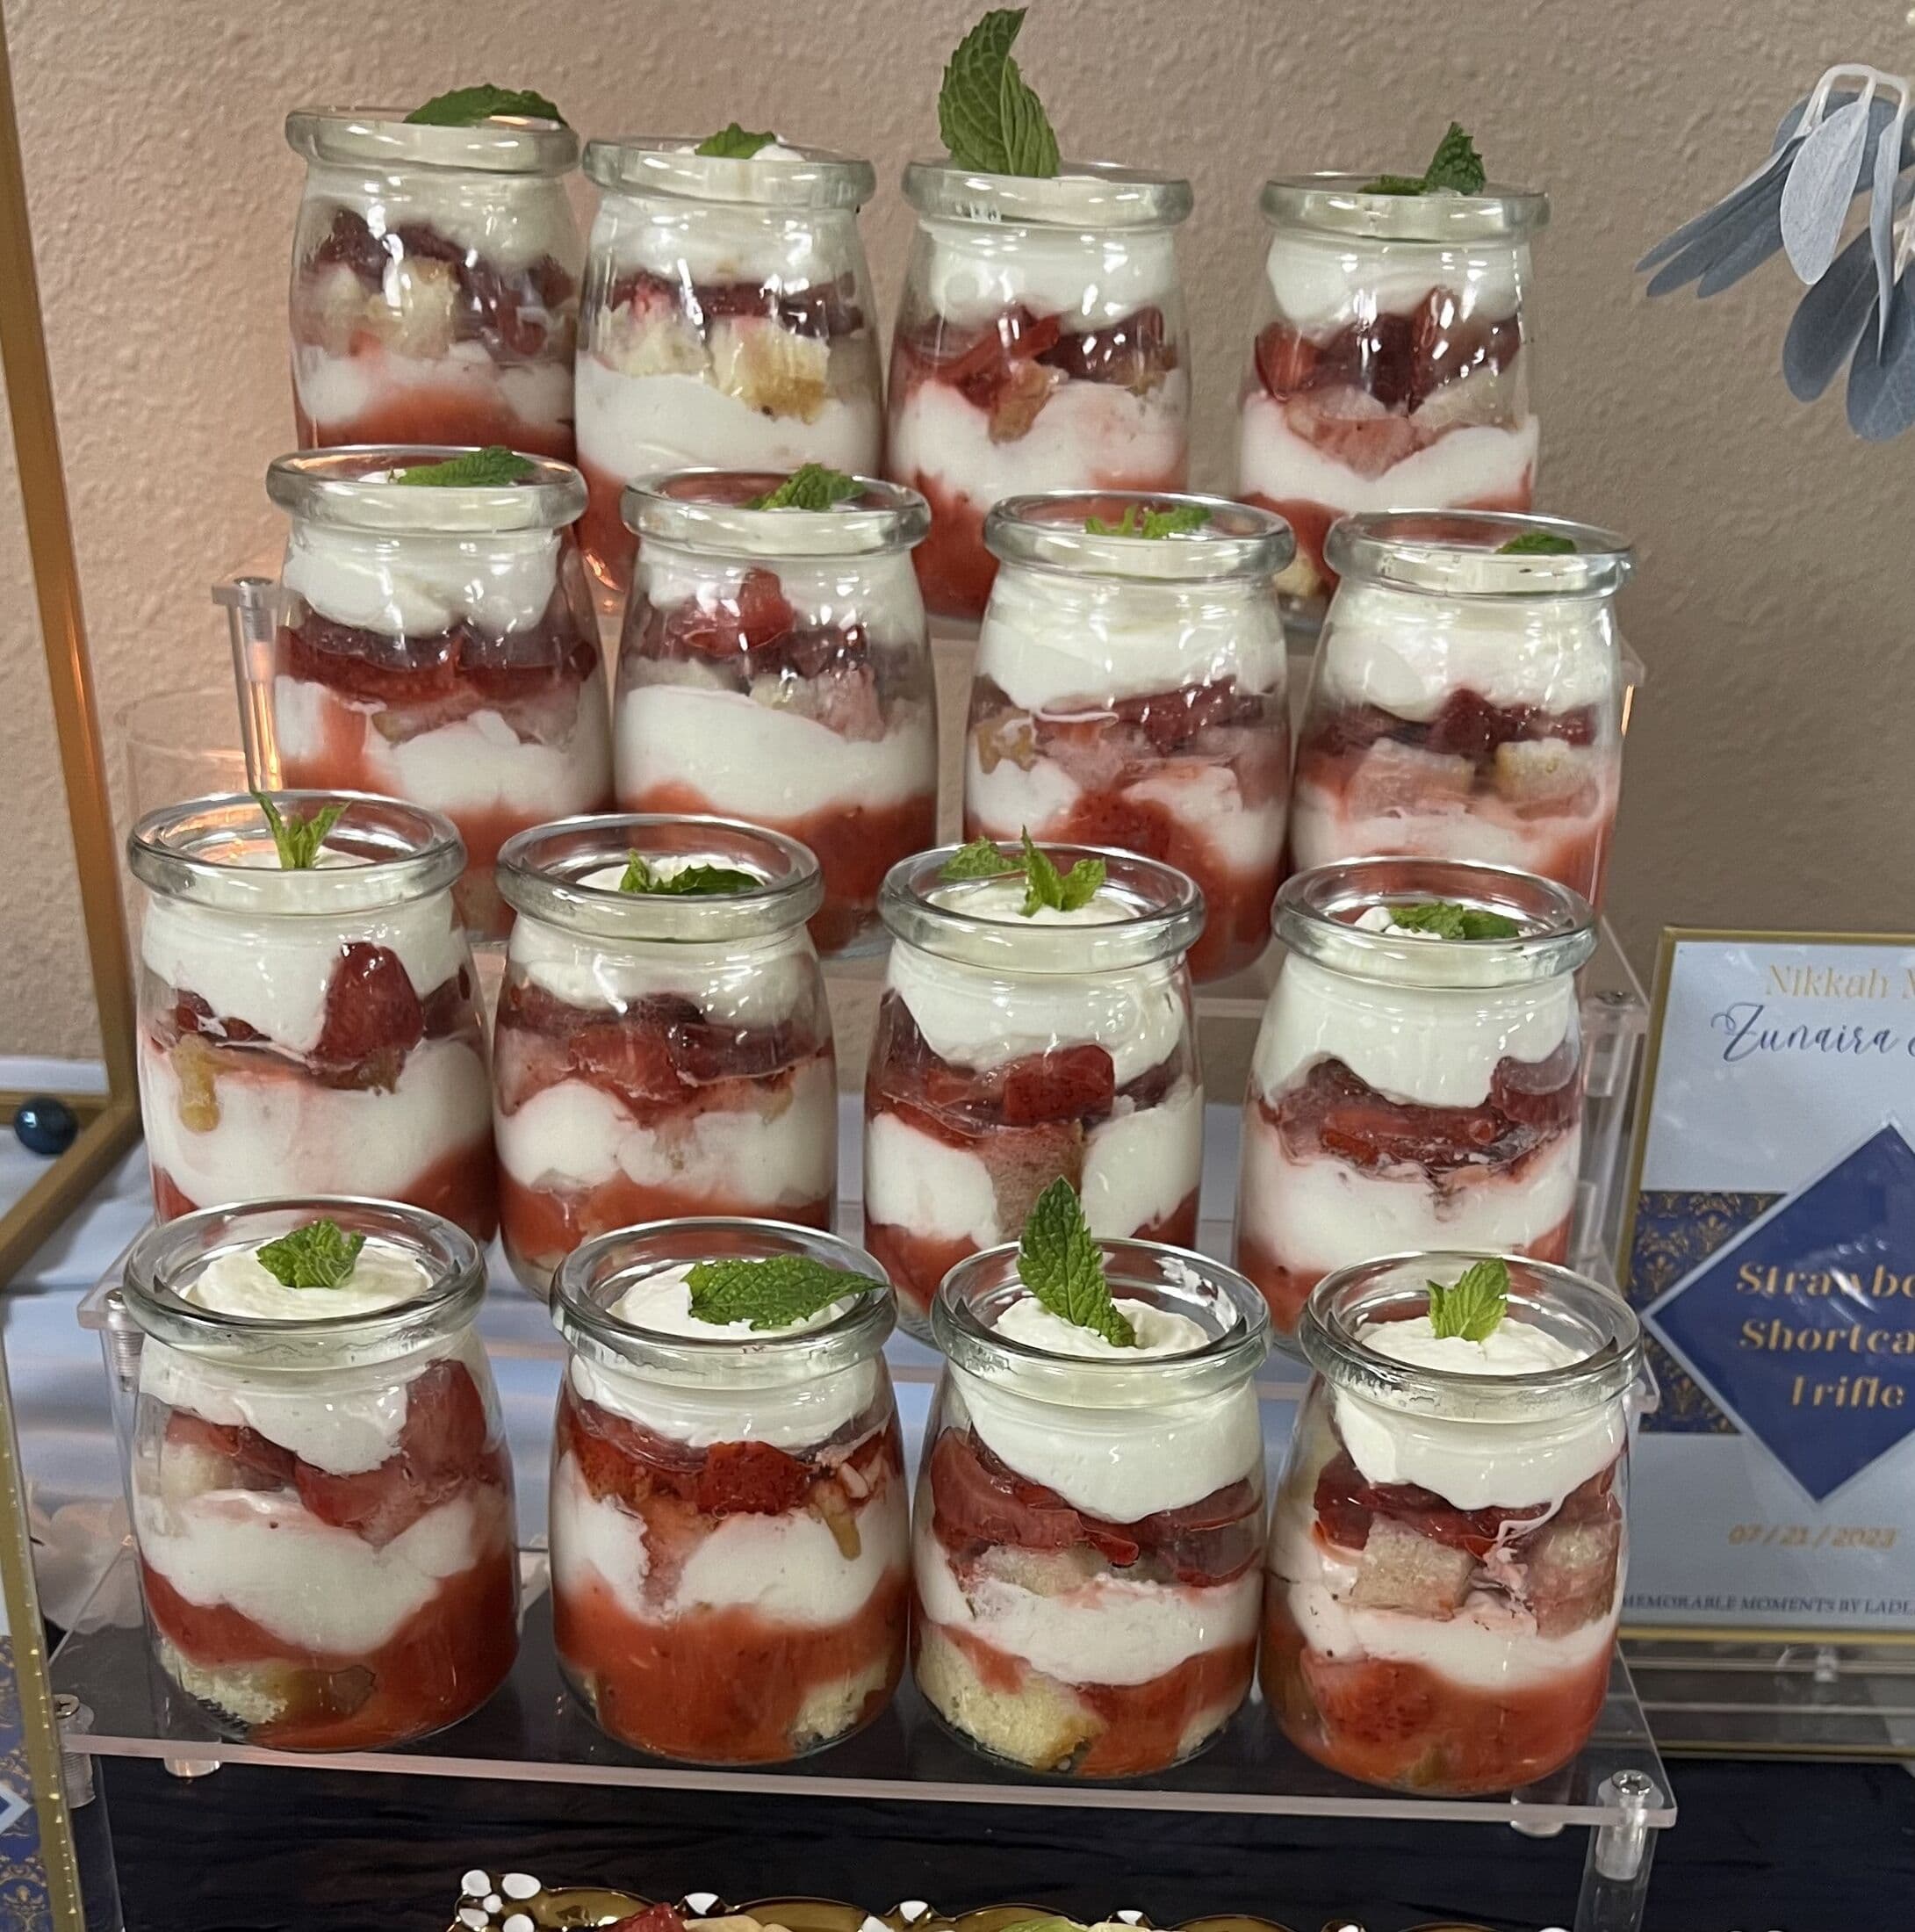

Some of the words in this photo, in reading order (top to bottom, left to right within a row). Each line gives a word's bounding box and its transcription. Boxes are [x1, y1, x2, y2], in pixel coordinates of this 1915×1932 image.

[1765, 964, 1891, 999] Nikkah
[1710, 1001, 1900, 1063] Zunaira
[1739, 1318, 1915, 1355] Shortca
[1790, 1374, 1905, 1409] Trifle
[1740, 1596, 1836, 1614] MOMENTS
[1839, 1597, 1861, 1614] BY
